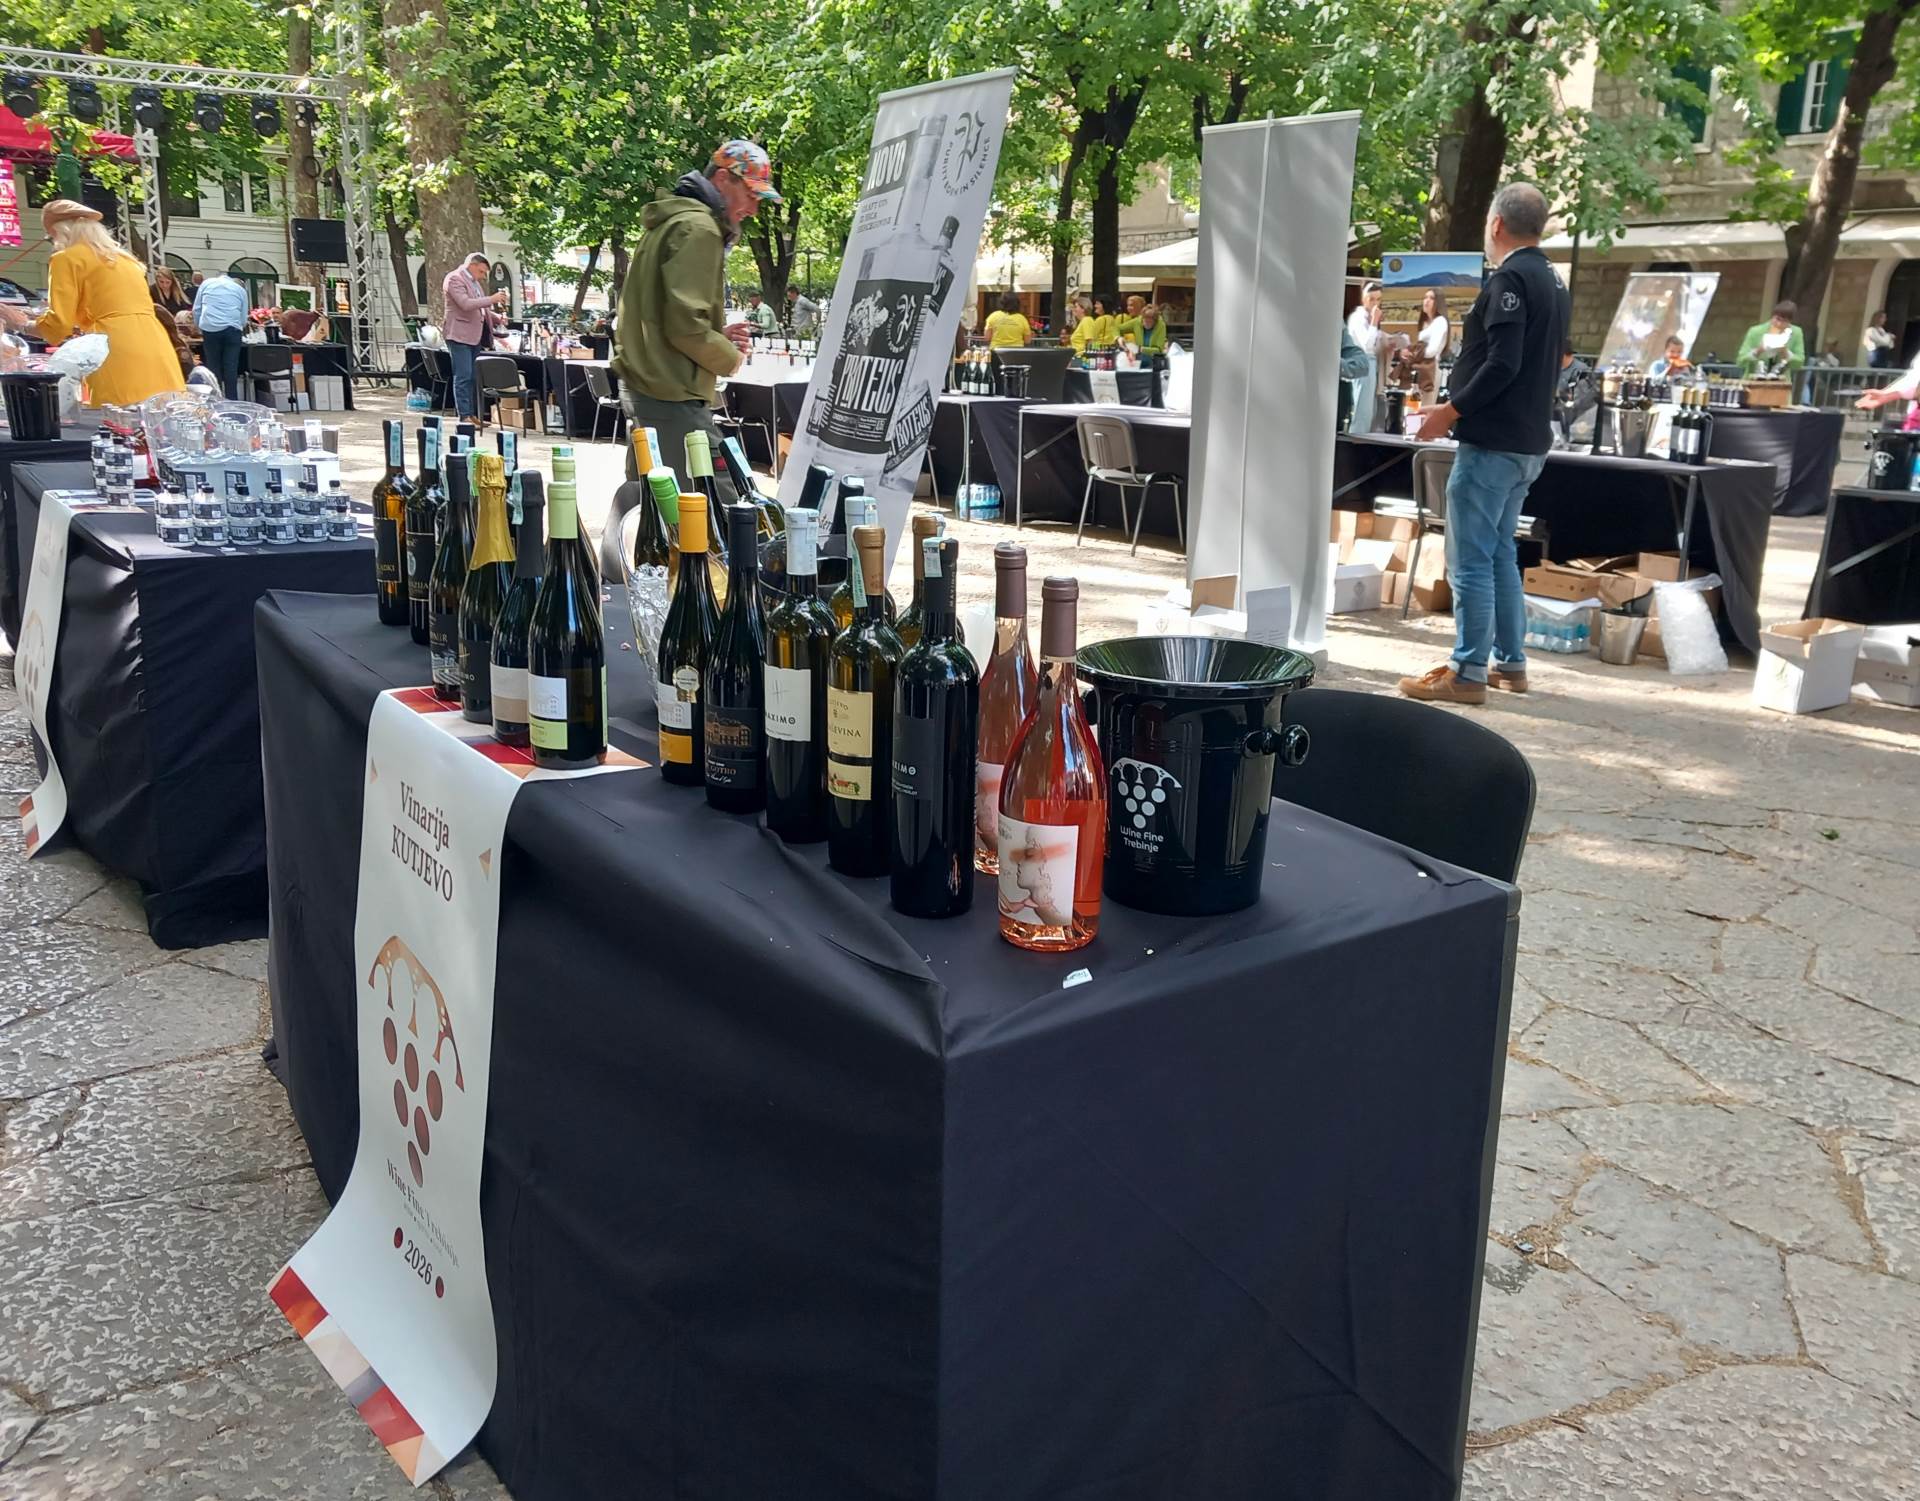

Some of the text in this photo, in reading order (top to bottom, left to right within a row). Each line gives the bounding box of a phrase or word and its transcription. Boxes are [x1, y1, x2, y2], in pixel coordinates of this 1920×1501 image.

[867, 139, 907, 192] NOVO
[893, 760, 917, 776] XIMO
[400, 780, 450, 853] Vinarija
[1120, 825, 1165, 843] Wine Fine
[391, 823, 454, 902] KUTJEVO
[1123, 836, 1160, 854] Trebinje
[386, 1158, 407, 1196] Wine
[407, 1184, 425, 1221] Fine
[404, 1239, 433, 1286] 2026
